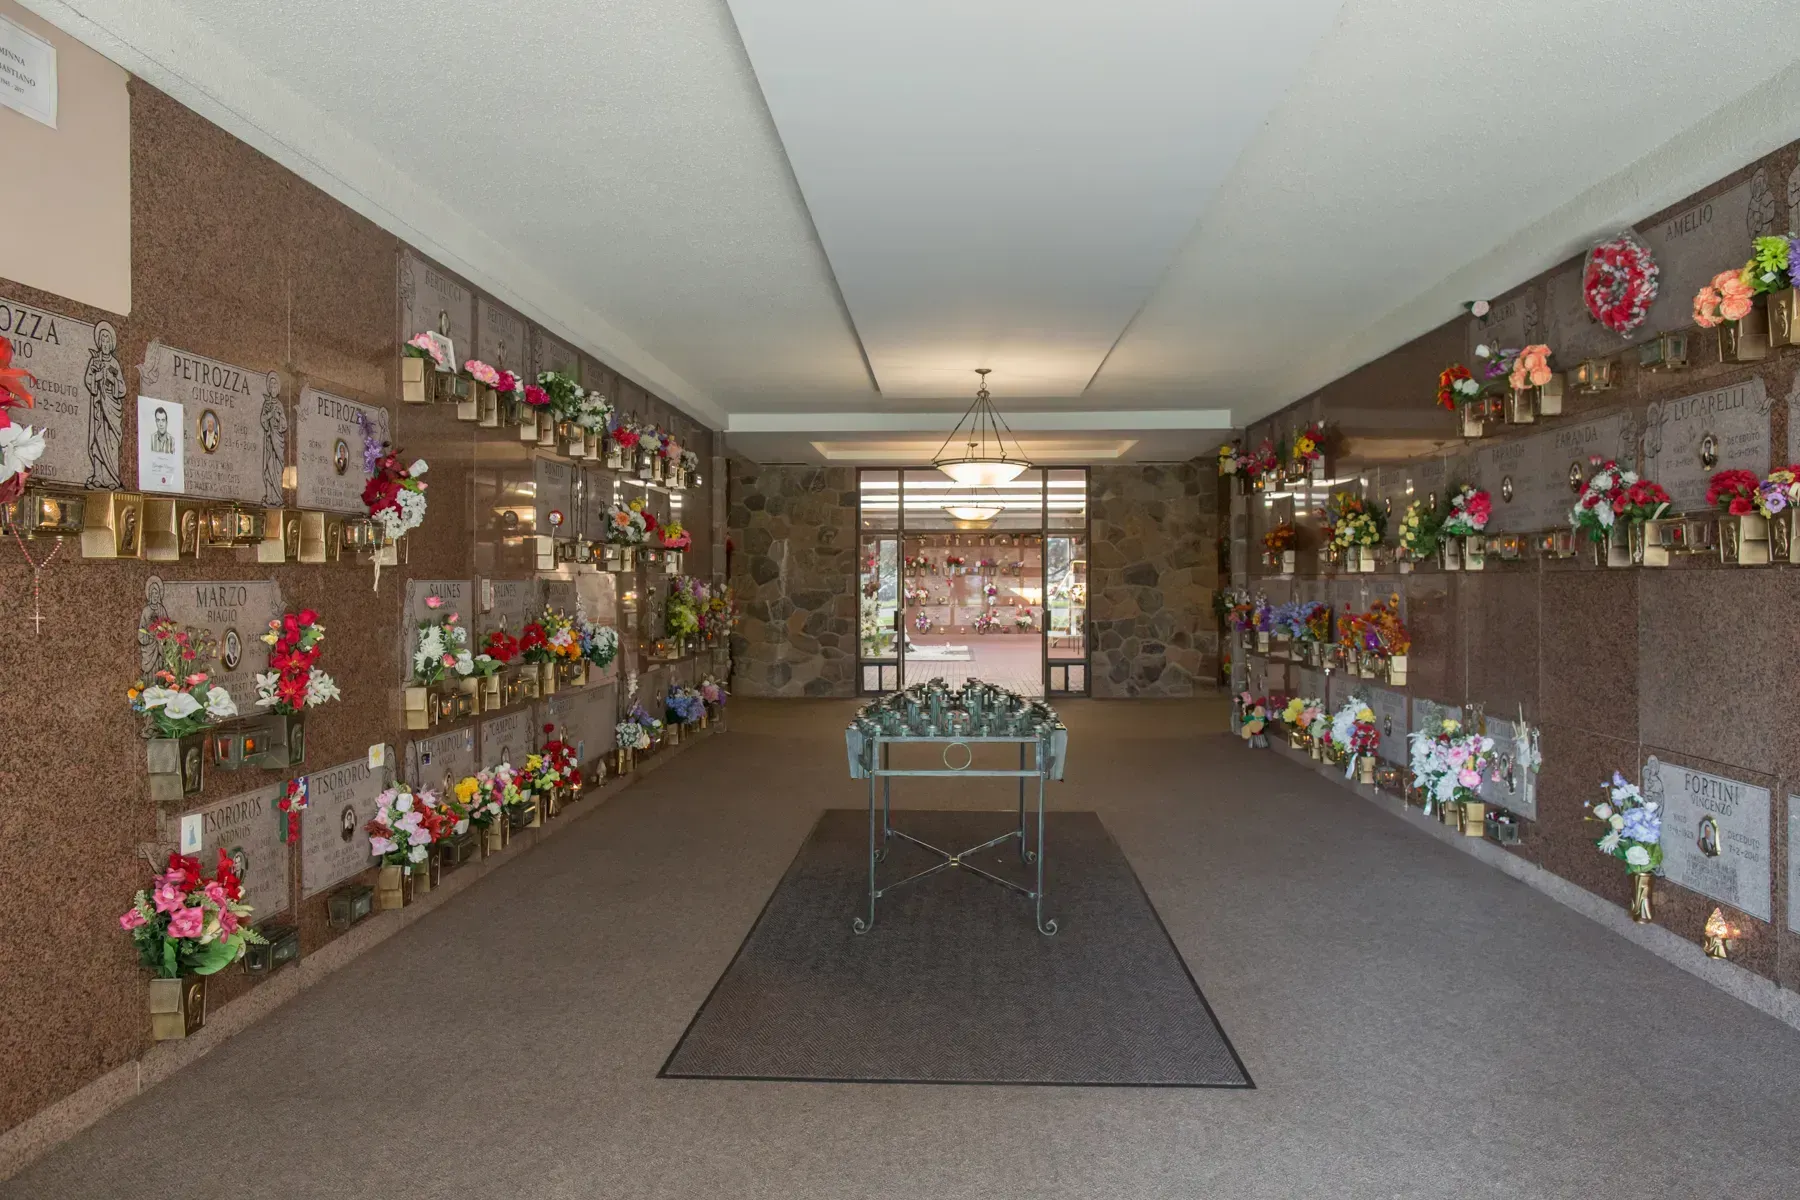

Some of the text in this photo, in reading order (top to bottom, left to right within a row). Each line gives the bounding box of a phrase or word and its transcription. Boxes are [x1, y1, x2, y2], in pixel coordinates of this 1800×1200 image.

[1665, 203, 1713, 242] AMELIO
[173, 354, 251, 396] PETROZZA
[192, 386, 235, 409] GIUSEPPE
[1674, 387, 1745, 421] LUCARELLI
[196, 585, 248, 608] MARZO
[429, 583, 461, 599] SALINES
[207, 609, 238, 623] BIAGIO
[316, 761, 371, 796] TSOROROS
[1684, 772, 1740, 806] FORTINI
[203, 796, 263, 835] TSOROROS
[1690, 793, 1733, 817] VINCENZO
[1727, 830, 1761, 849] DECEDUTO
